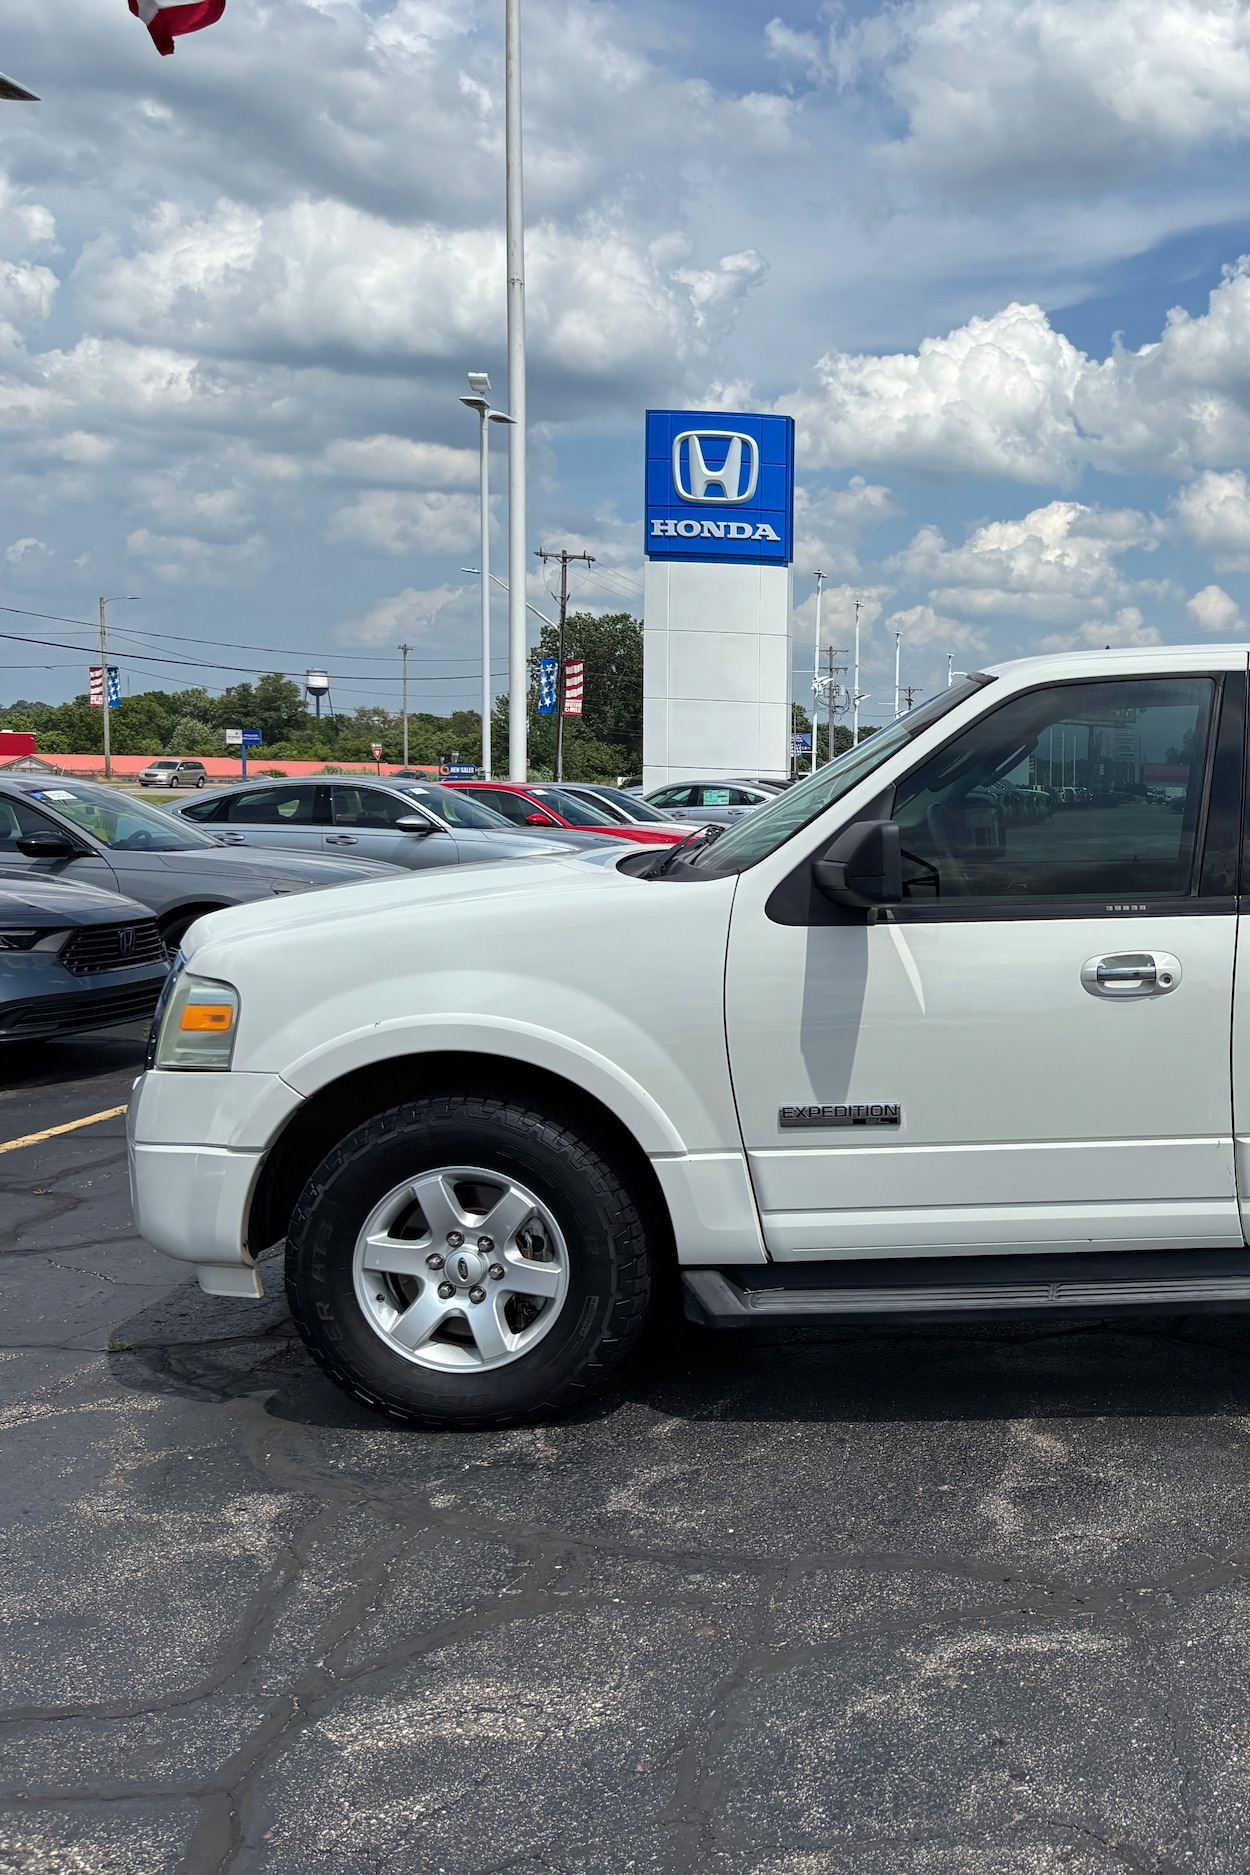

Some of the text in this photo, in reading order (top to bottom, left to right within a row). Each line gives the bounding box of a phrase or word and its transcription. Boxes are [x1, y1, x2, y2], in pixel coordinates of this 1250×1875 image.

[650, 519, 781, 541] HONDA
[781, 1104, 898, 1119] EXPEDITION
[312, 1218, 334, 1284] AT3
